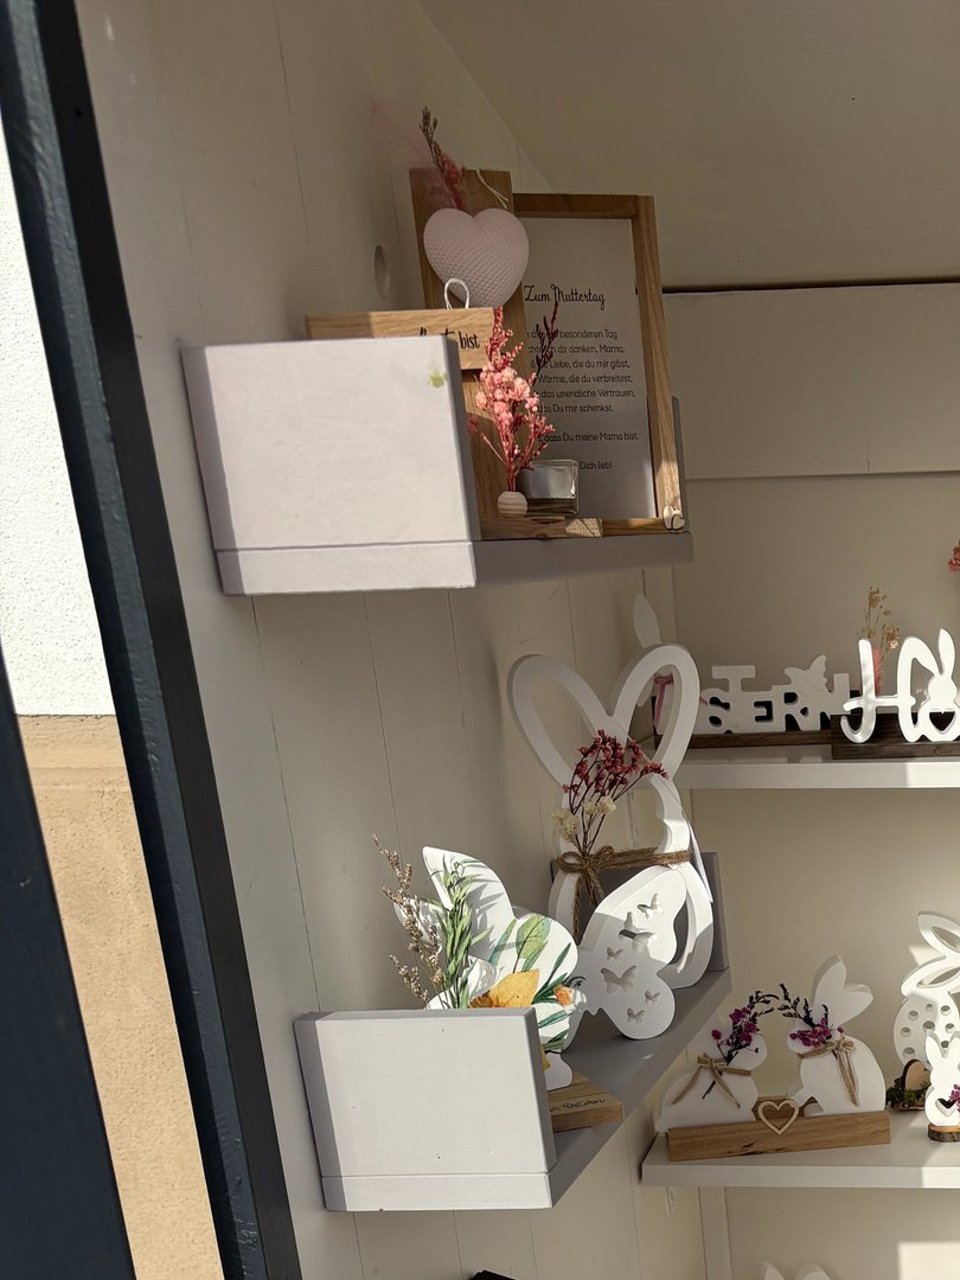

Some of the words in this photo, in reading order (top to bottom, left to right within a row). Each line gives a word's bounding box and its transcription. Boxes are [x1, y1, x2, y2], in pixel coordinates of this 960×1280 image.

[523, 285, 549, 302] Zum
[551, 284, 605, 311] Muttertag
[458, 331, 480, 349] bist
[584, 359, 596, 369] du
[581, 373, 591, 383] du
[600, 431, 623, 442] Mama
